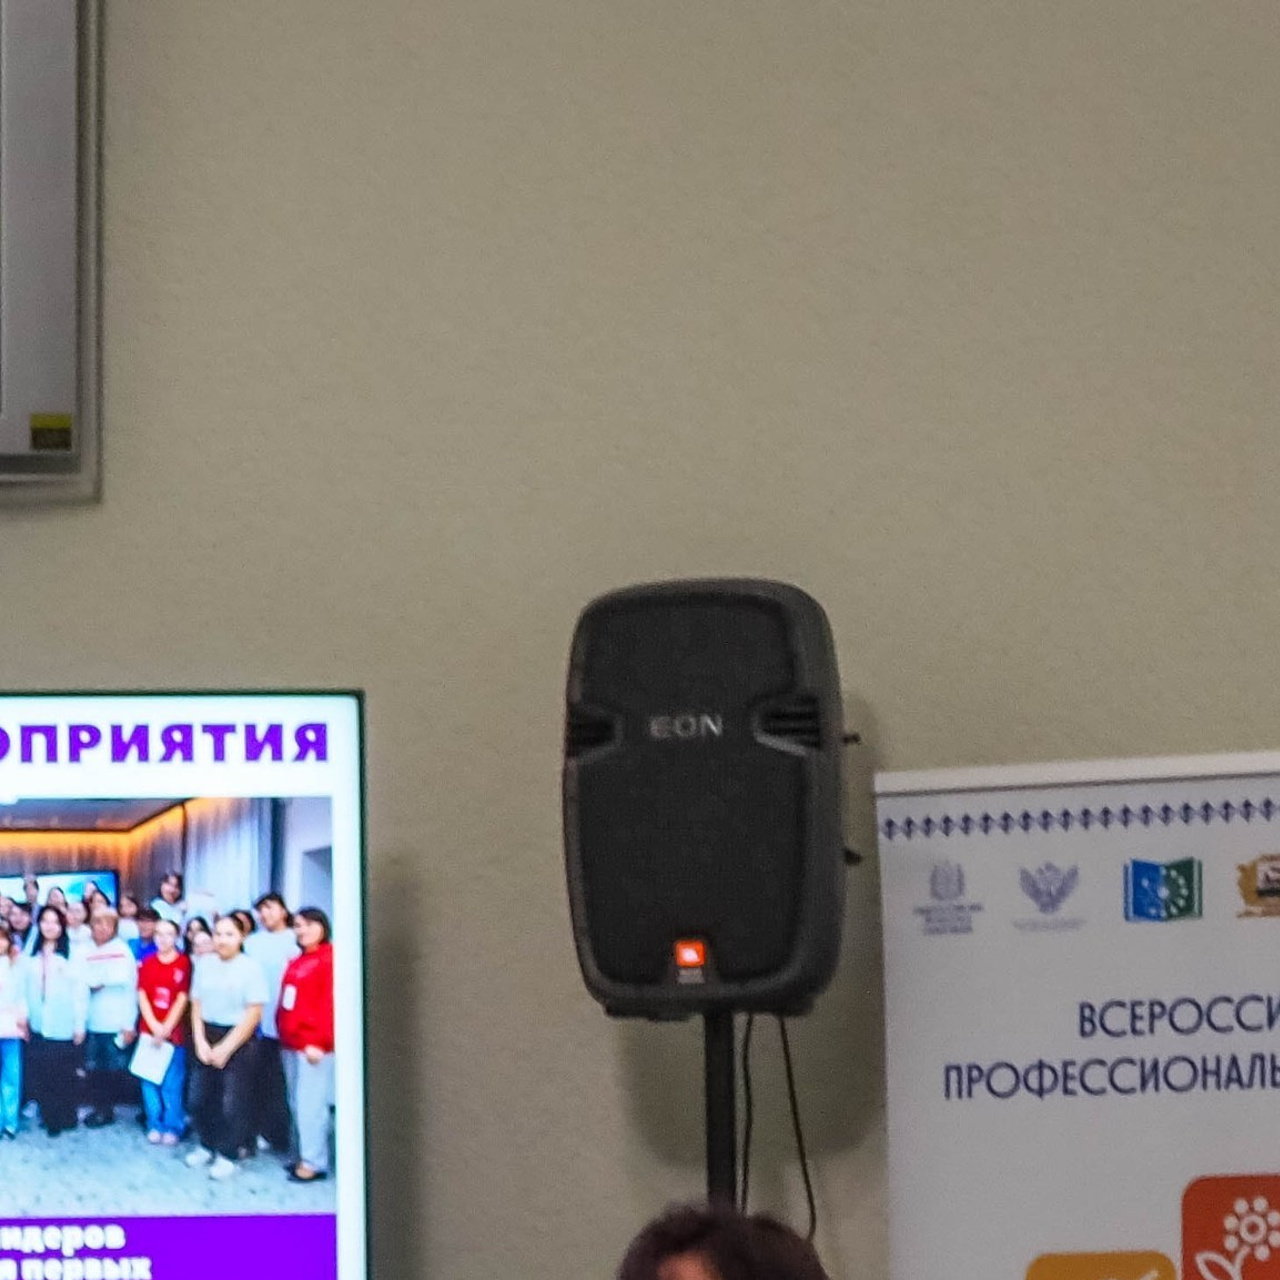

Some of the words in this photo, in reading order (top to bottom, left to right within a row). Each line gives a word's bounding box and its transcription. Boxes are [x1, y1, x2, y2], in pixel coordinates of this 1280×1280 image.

[650, 713, 723, 738] EON
[1079, 994, 1280, 1038] ВСЕРОССИ
[943, 1052, 1280, 1100] ПРОФЕССИОНАЛЬ
